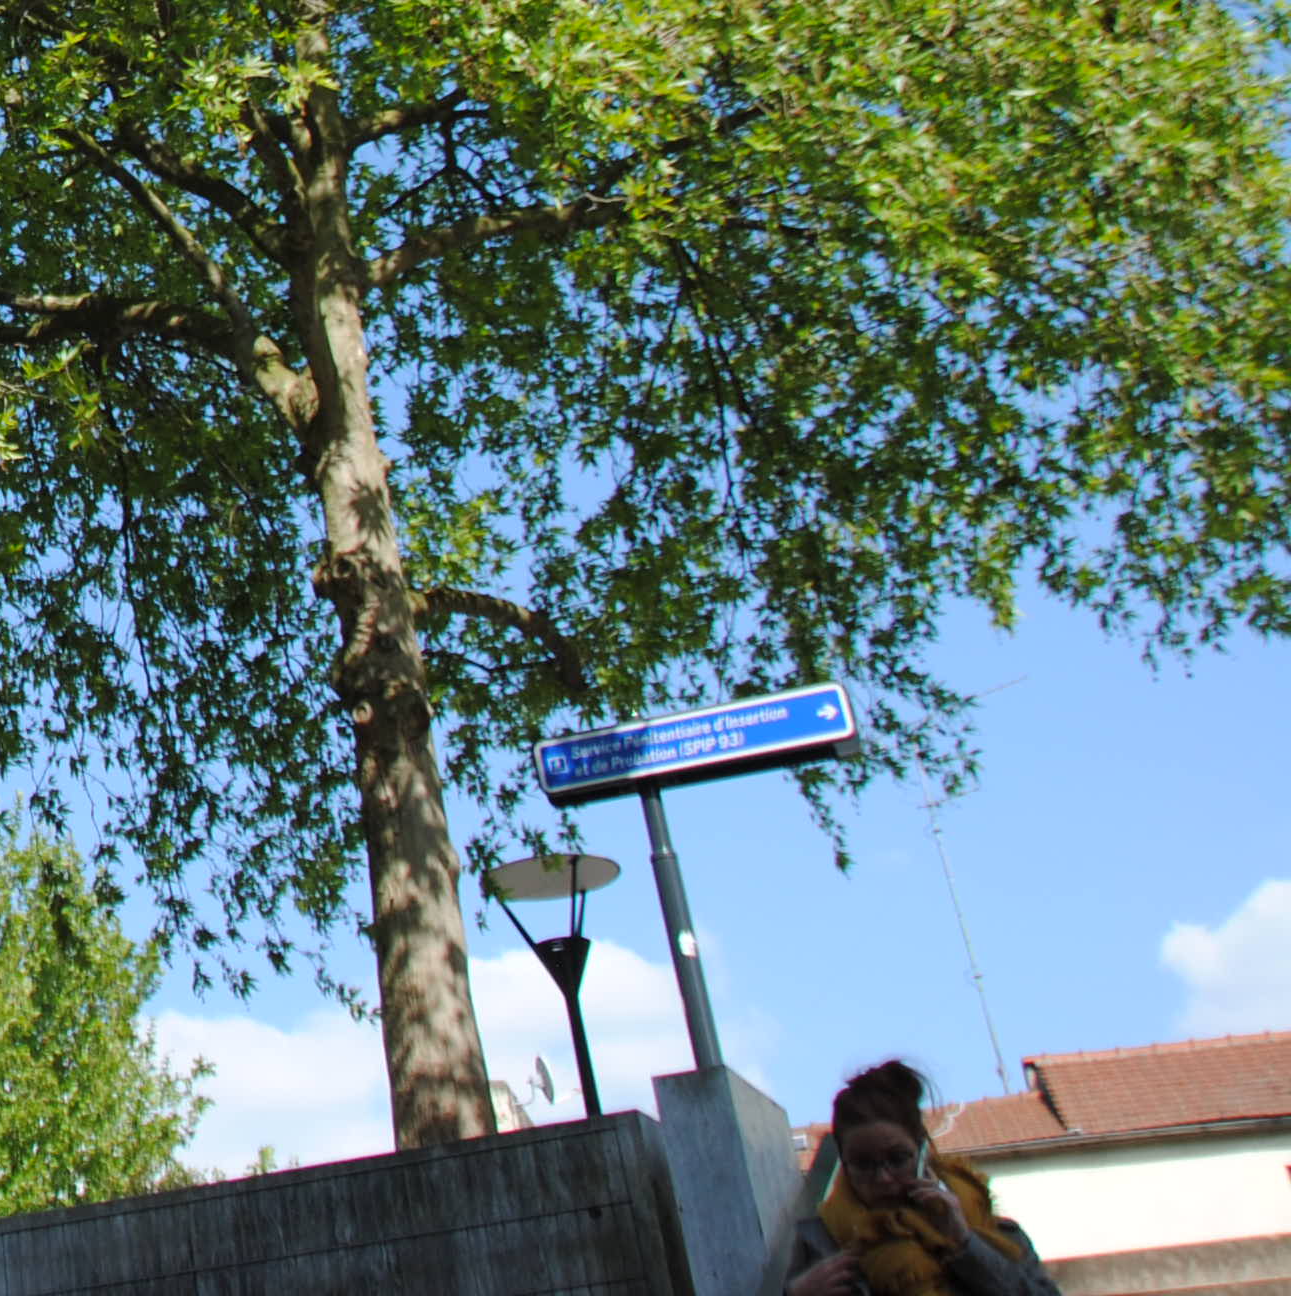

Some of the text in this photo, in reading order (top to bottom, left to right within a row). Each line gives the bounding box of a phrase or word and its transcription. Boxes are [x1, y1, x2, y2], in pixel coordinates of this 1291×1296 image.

[570, 738, 620, 760] Service
[574, 759, 590, 778] et
[591, 757, 609, 774] de
